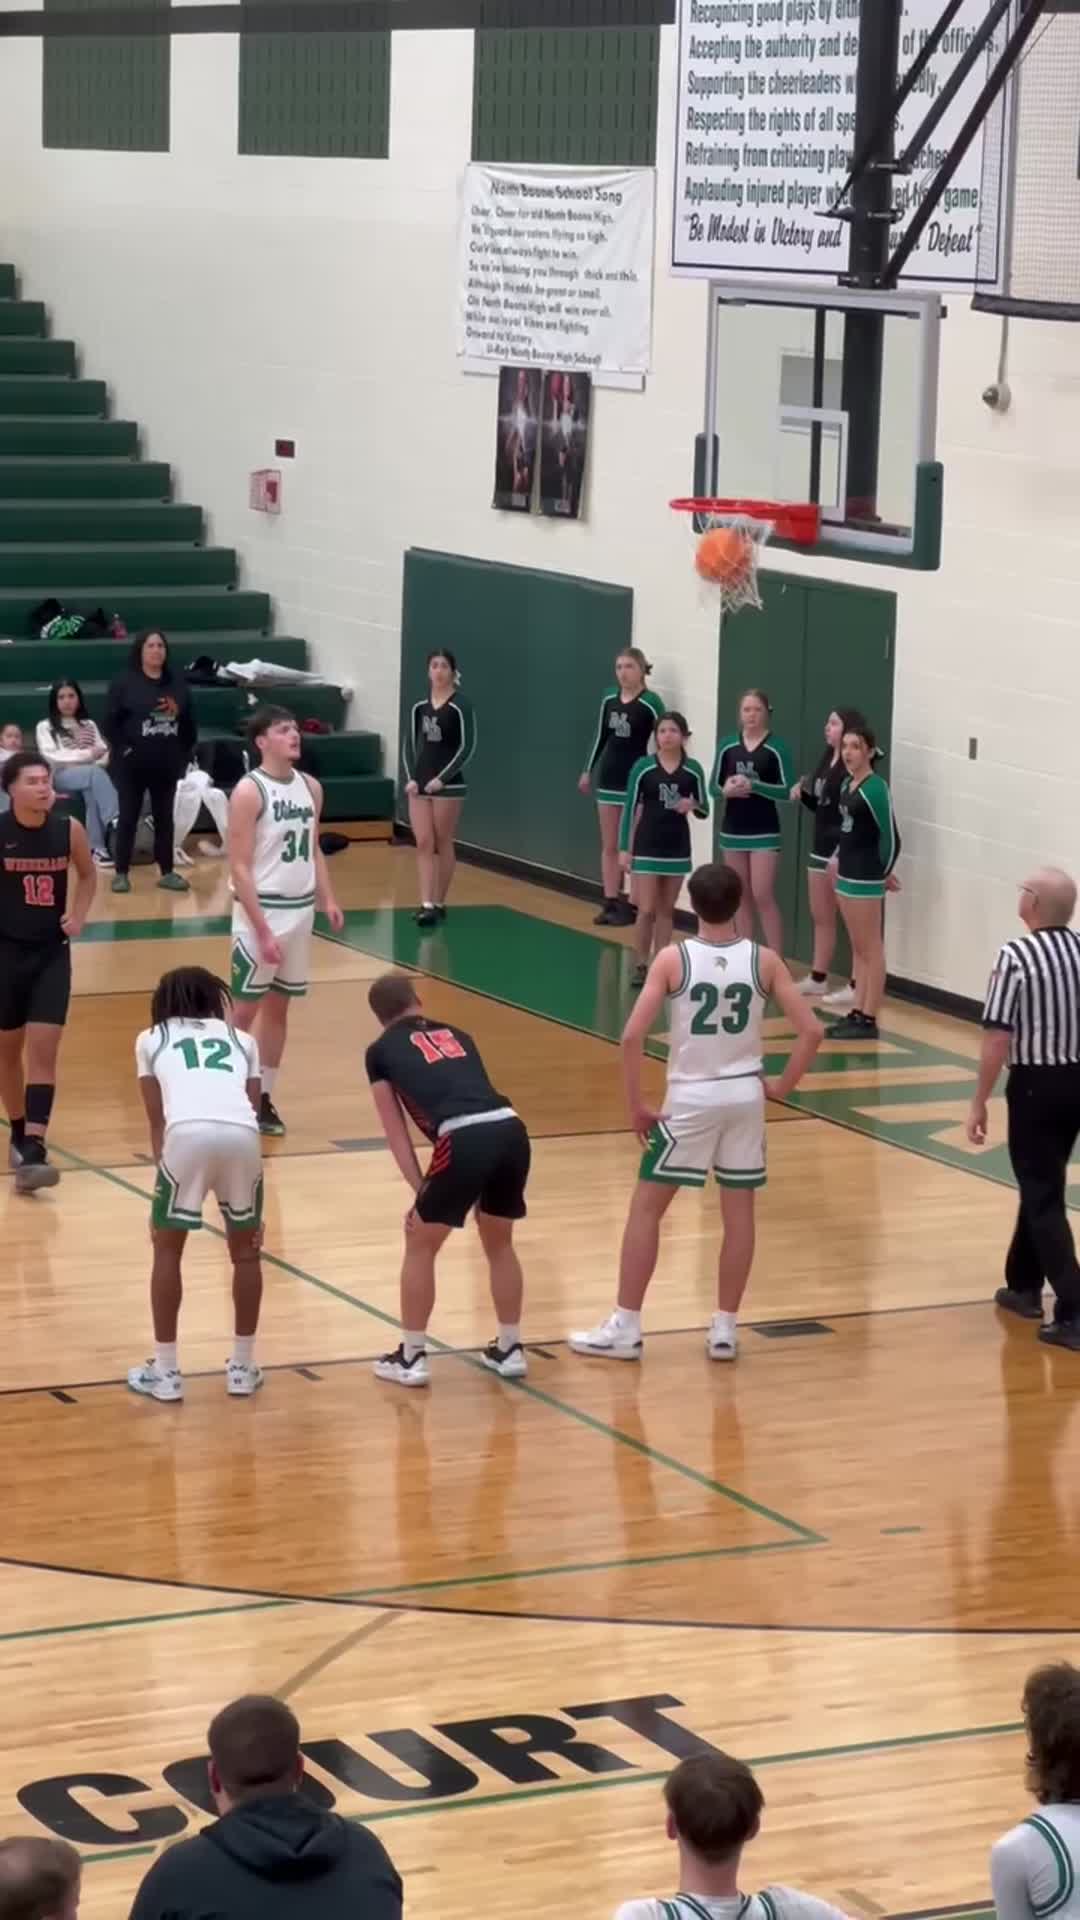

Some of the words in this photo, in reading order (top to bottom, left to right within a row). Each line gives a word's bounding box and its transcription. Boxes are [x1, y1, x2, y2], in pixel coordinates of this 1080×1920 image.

[690, 0, 753, 28] Recognizing
[757, 0, 784, 27] good
[787, 0, 815, 26] plays
[689, 35, 741, 64] Accepting
[745, 35, 763, 59] the
[765, 33, 816, 63] authority
[819, 32, 841, 57] and
[903, 28, 915, 55] of
[688, 70, 745, 100] Supporting
[748, 71, 766, 95] the
[768, 69, 842, 96] cheerleaders
[687, 106, 745, 136] Respecting
[749, 107, 767, 131] the
[769, 107, 801, 137] rights
[804, 106, 816, 131] of
[819, 106, 834, 131] all
[686, 142, 740, 172] Refraining
[743, 142, 768, 167] from
[770, 143, 826, 174] criticizing
[555, 185, 592, 200] School
[595, 186, 623, 207] Song
[685, 177, 744, 207] Applauding
[747, 178, 784, 208] injured
[787, 180, 823, 209] player
[708, 213, 750, 243] Modest
[754, 218, 765, 244] in
[771, 216, 814, 254] Victory
[817, 221, 844, 248] and
[281, 828, 310, 863] 34
[23, 874, 55, 906] 12
[690, 982, 752, 1035] 23
[173, 1037, 234, 1072] 12
[410, 1028, 467, 1064] 15
[16, 1693, 737, 1845] COURT
